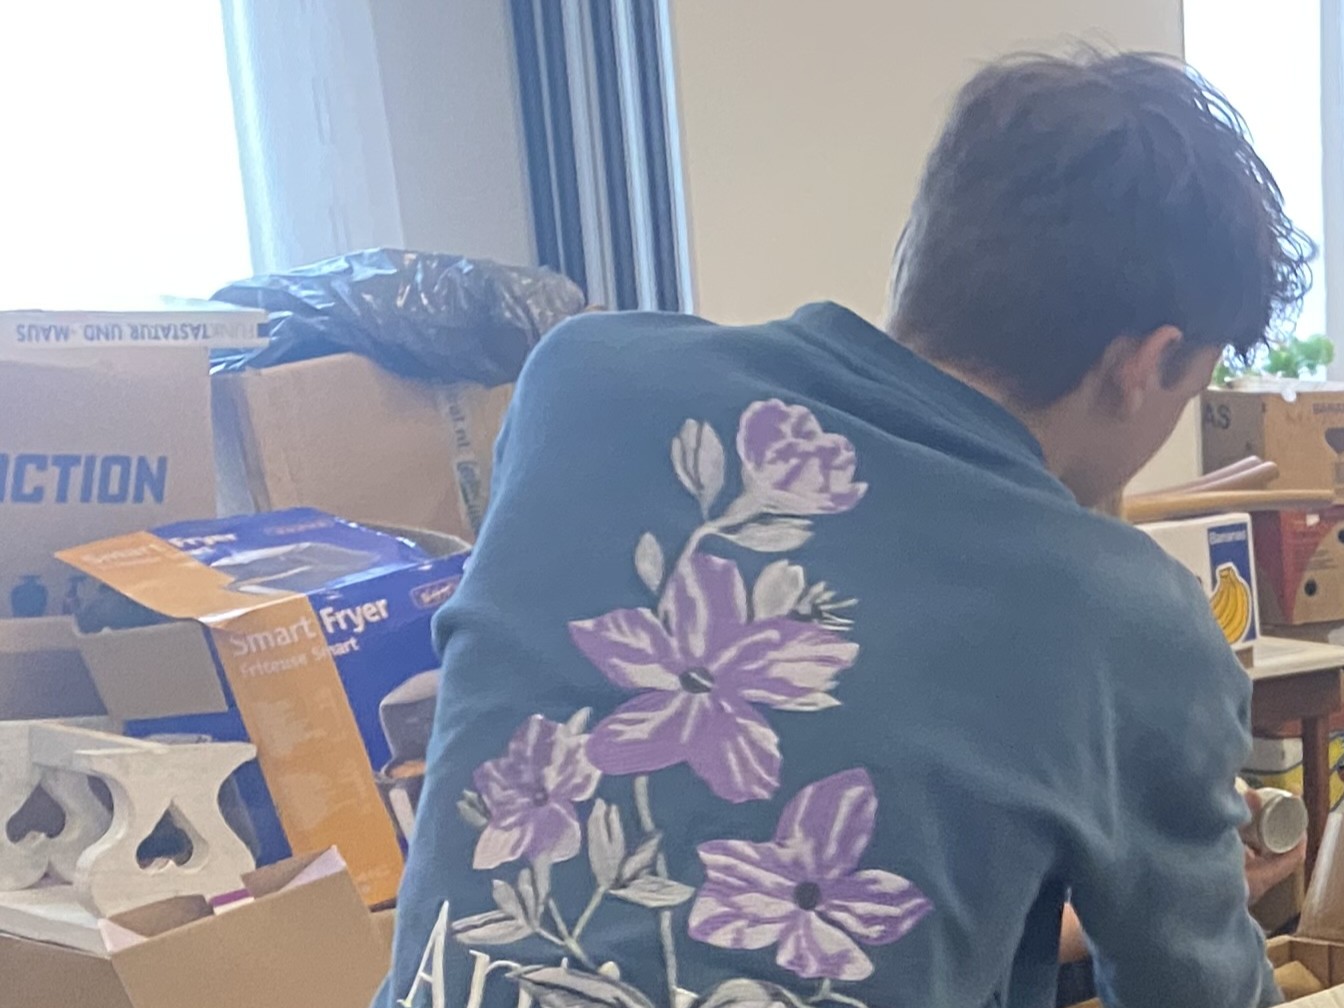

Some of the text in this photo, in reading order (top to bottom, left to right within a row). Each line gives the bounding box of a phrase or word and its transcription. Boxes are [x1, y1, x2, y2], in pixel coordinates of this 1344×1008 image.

[83, 323, 123, 342] UND
[230, 598, 390, 657] Smart Fryer
